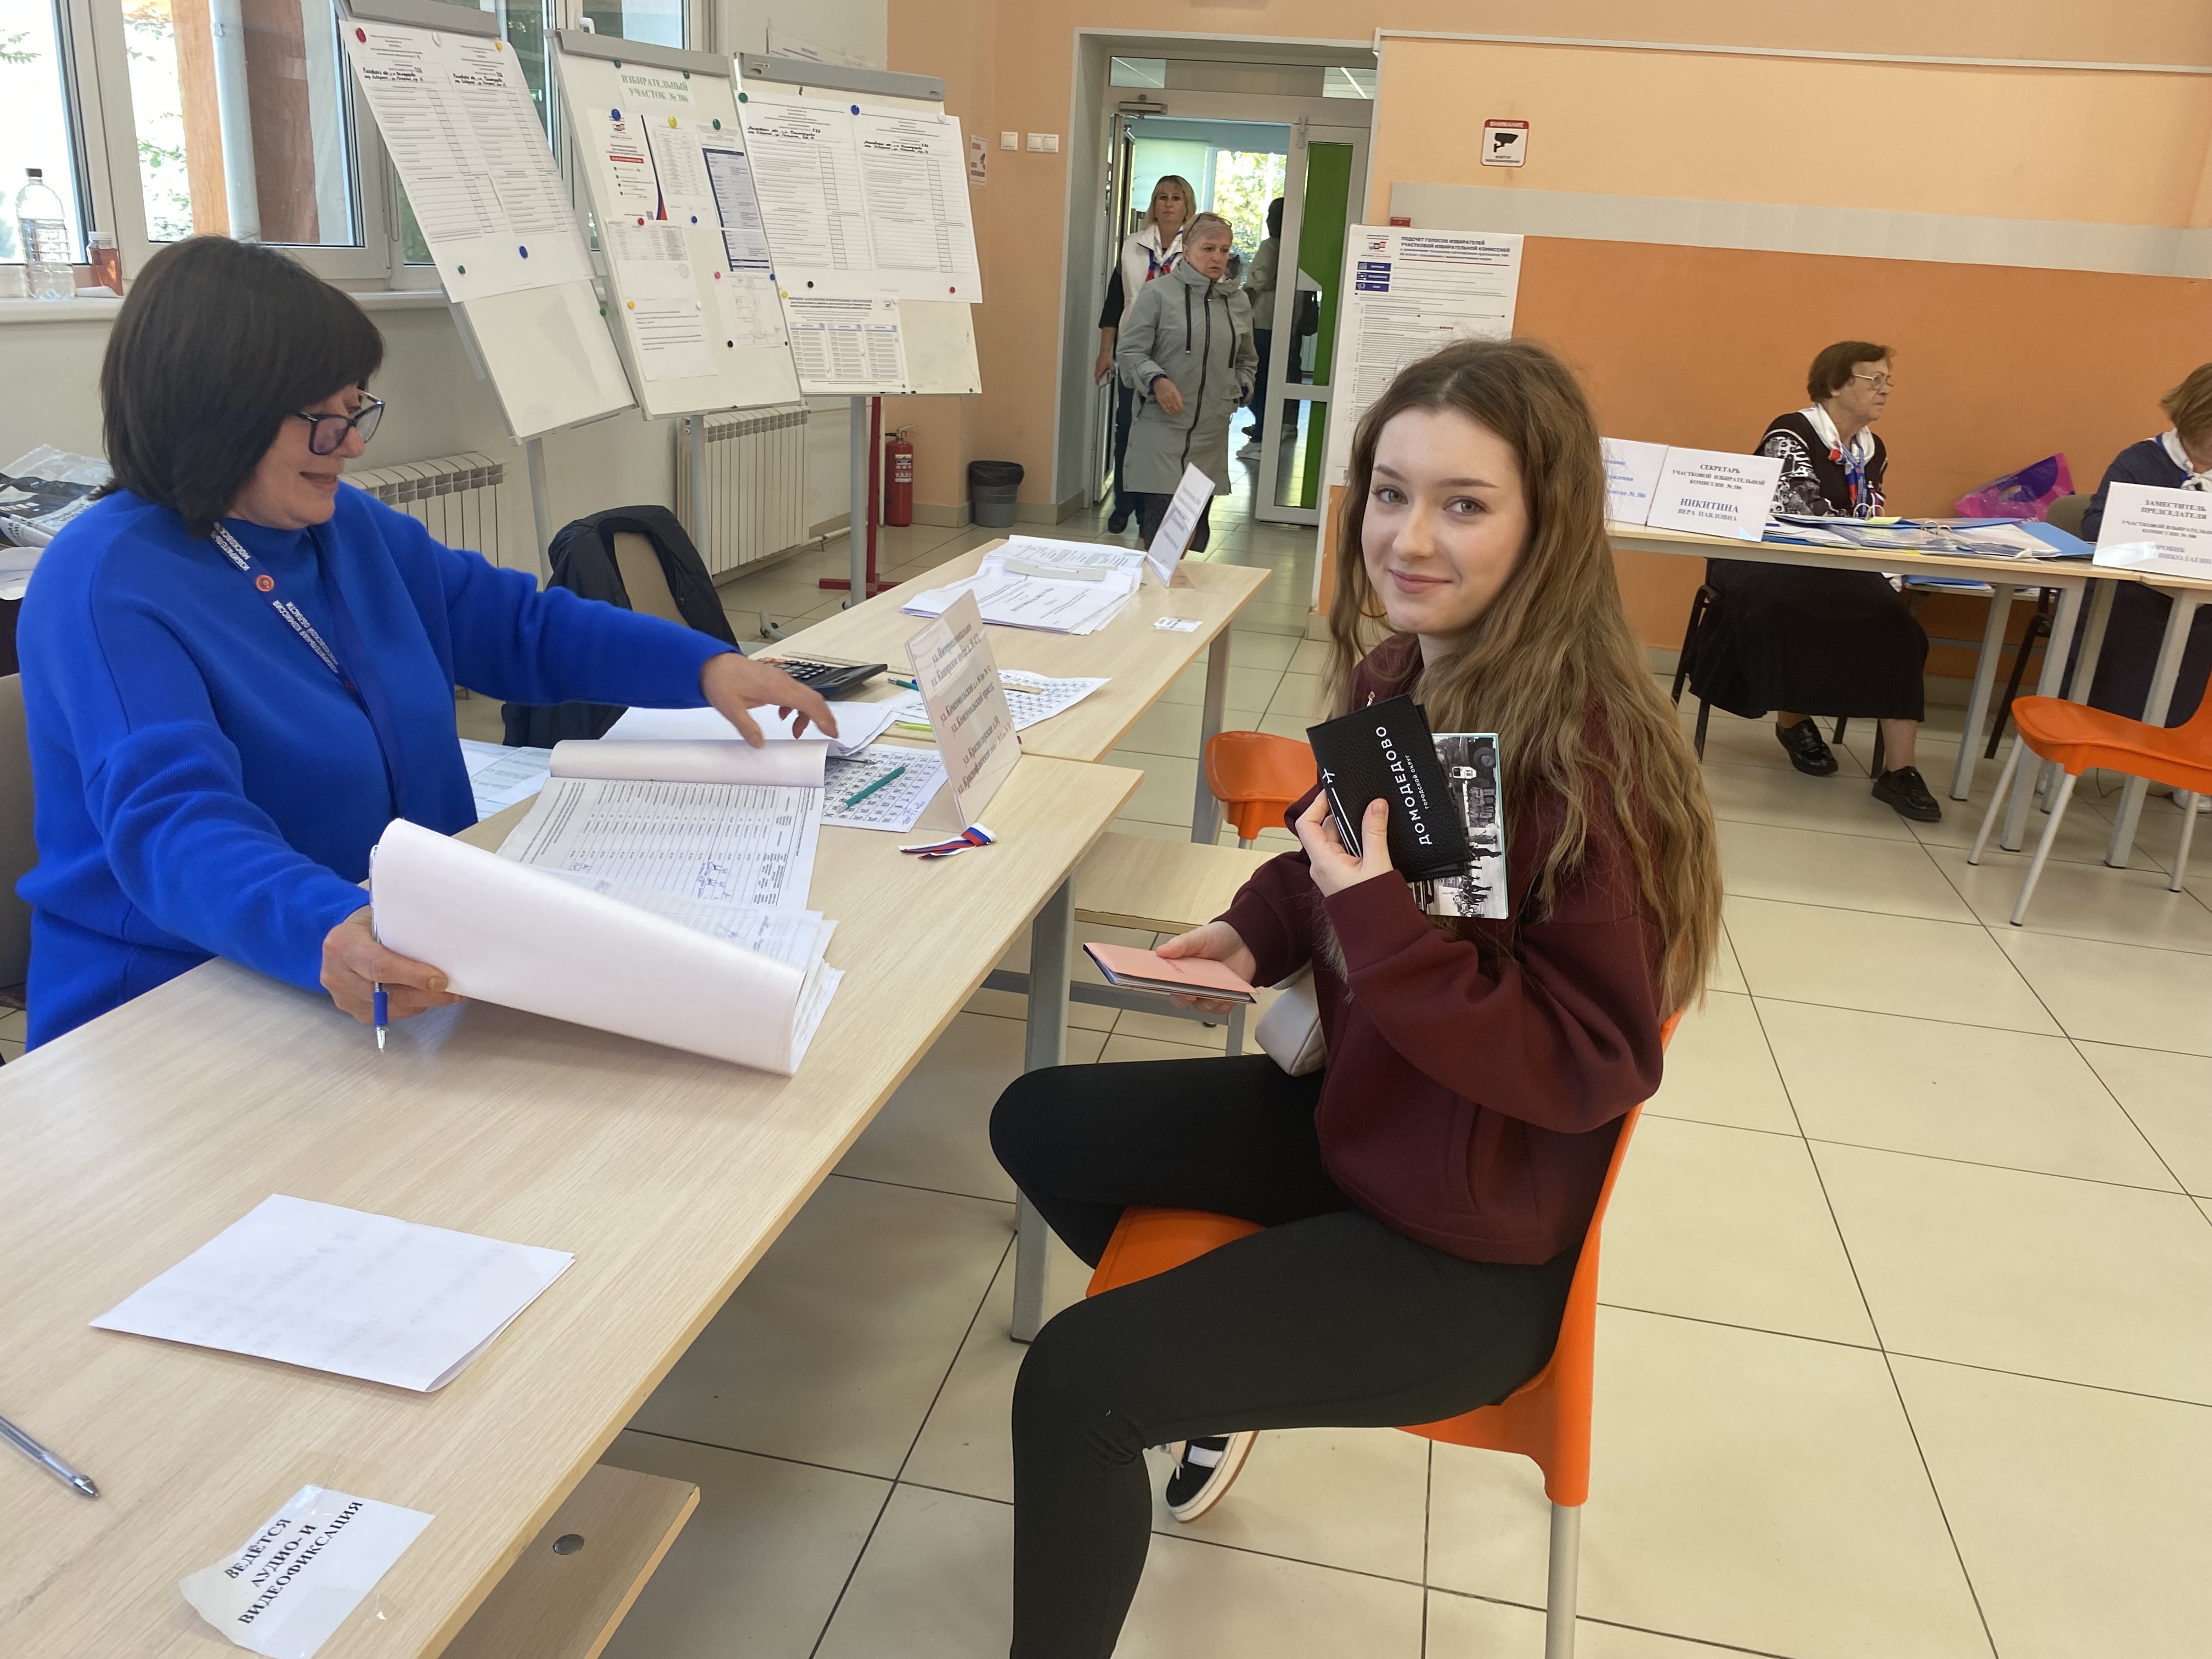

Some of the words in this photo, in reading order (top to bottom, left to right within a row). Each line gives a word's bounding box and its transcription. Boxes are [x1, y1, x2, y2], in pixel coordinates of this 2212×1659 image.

[621, 75, 689, 92] ИЗБИРАТЕЛЬНЫЙ
[628, 88, 667, 99] УЧАСТОК
[669, 93, 677, 101] №
[1700, 464, 1740, 474] СЕКРЕТАРЬ
[1672, 470, 1712, 479] УЧАСТКОВОЙ
[1714, 475, 1765, 486] ИЗБИРАТЕЛЬНОЙ
[1690, 479, 1724, 488] КОМИССИИ
[1680, 498, 1739, 514] НИКИТИНА
[2141, 507, 2208, 520] ПРЕДСЕДАТЕЛЯ
[2145, 500, 2207, 512] ЗАМЕСТИТЕЛЬ
[1699, 511, 1737, 522] ПАВЛОВНА
[2121, 520, 2165, 529] УЧАСТКОВОЙ
[2142, 528, 2179, 537] КОМИССИИ
[273, 600, 302, 632] КОМИССИЯ
[286, 601, 311, 628] ОБЛАСТИ
[945, 684, 974, 717] Комсомольская
[956, 692, 984, 728] Комсомольский
[1404, 755, 1415, 773] ОКРУГ
[1376, 726, 1432, 845] ДОМОДЕДОВО
[1412, 774, 1429, 809] ГОРОДСКОЙ
[224, 1519, 292, 1579] ВЕДЁТСЯ
[251, 1536, 303, 1588] АУДИО-
[300, 1524, 317, 1536] И
[238, 1502, 363, 1624] ВИДЕОФИКСАЦИЯ
